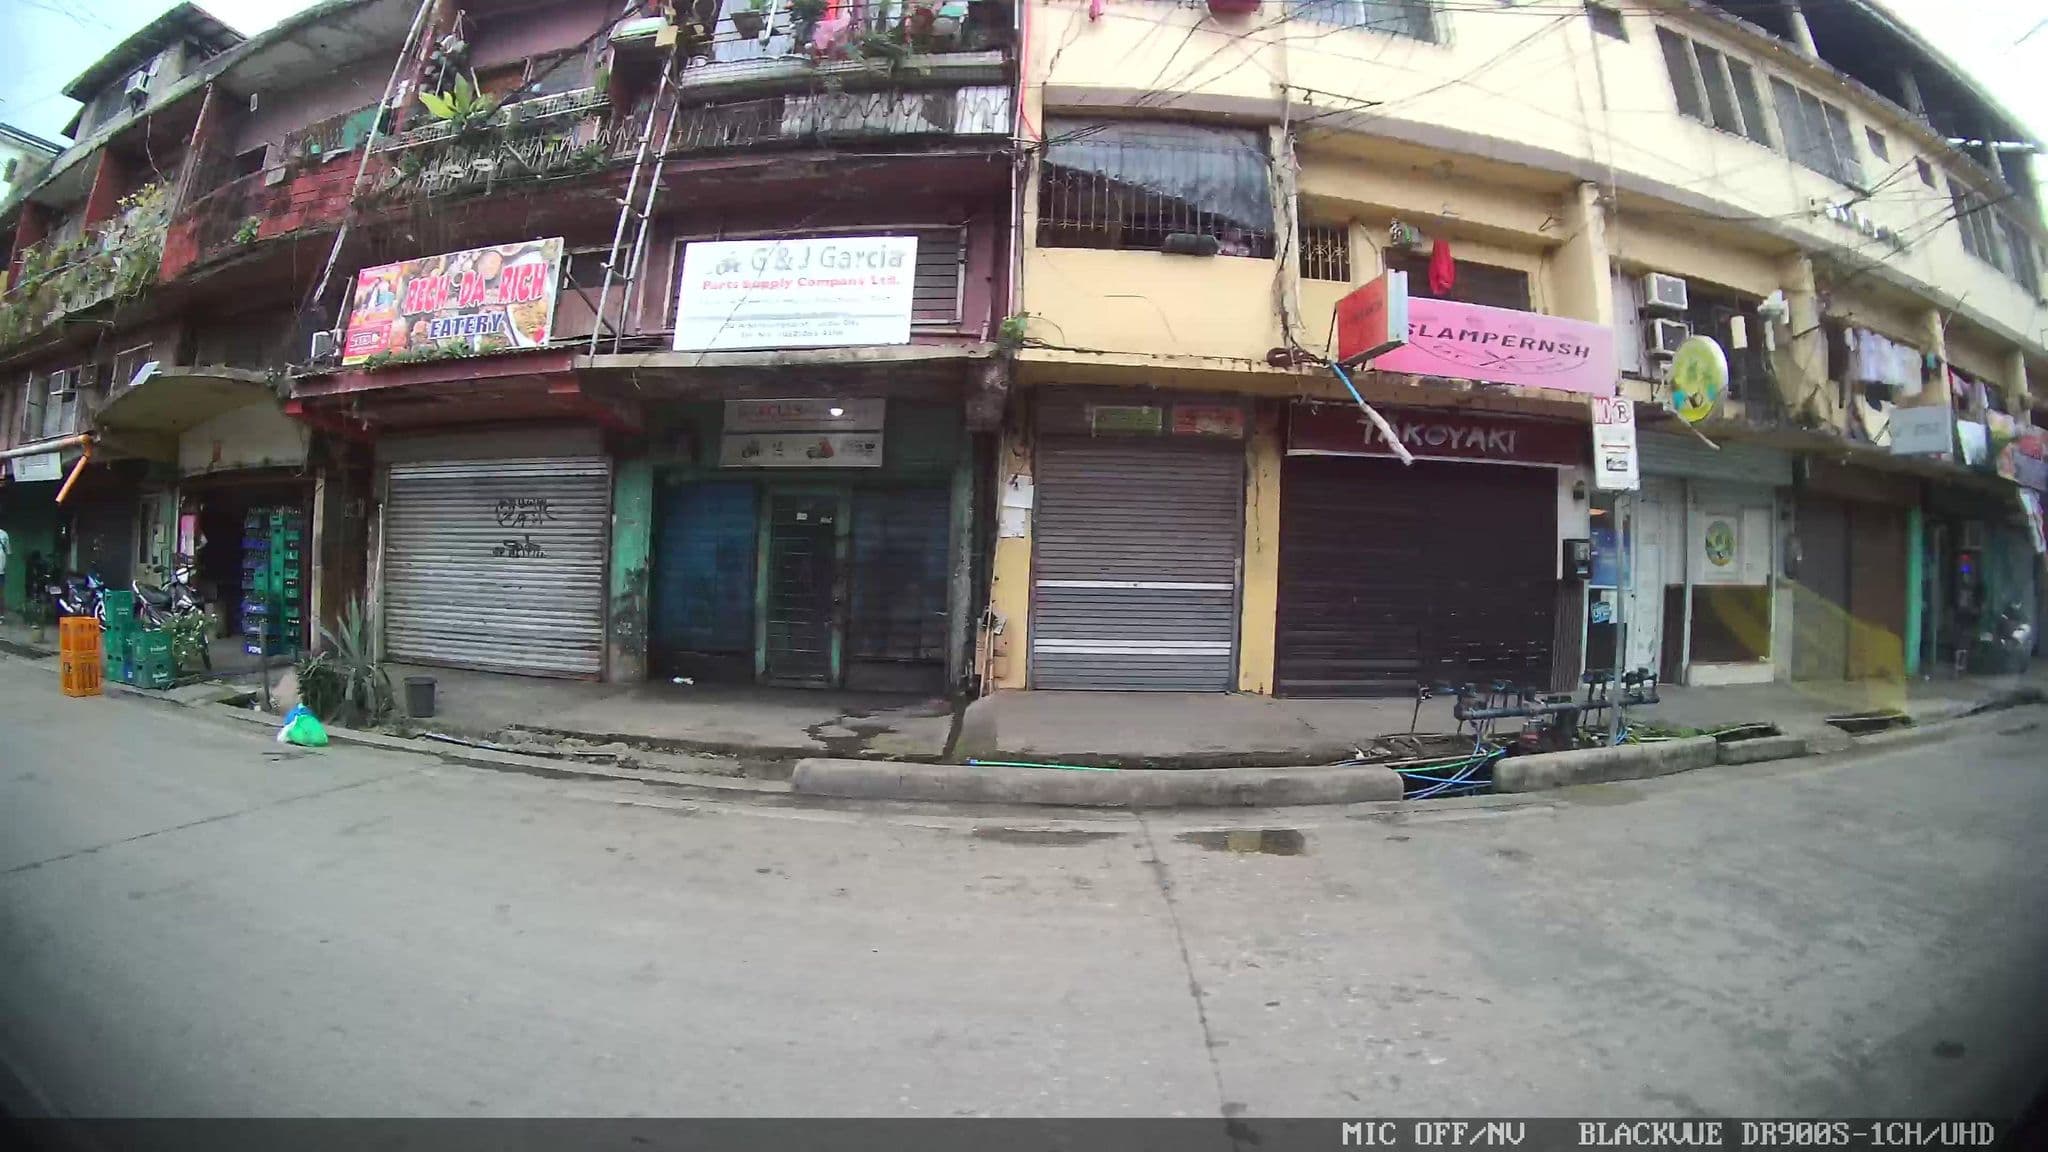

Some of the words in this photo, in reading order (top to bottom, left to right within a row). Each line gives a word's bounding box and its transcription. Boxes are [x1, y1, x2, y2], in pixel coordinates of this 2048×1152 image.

[751, 247, 769, 272] G
[774, 246, 793, 271] &
[798, 246, 811, 270] J
[820, 244, 905, 270] Garcia
[458, 271, 486, 308] DA
[498, 262, 549, 304] RICH
[702, 279, 740, 291] Parts
[742, 277, 794, 290] Supply
[797, 276, 866, 289] Company
[430, 313, 503, 339] EATERY
